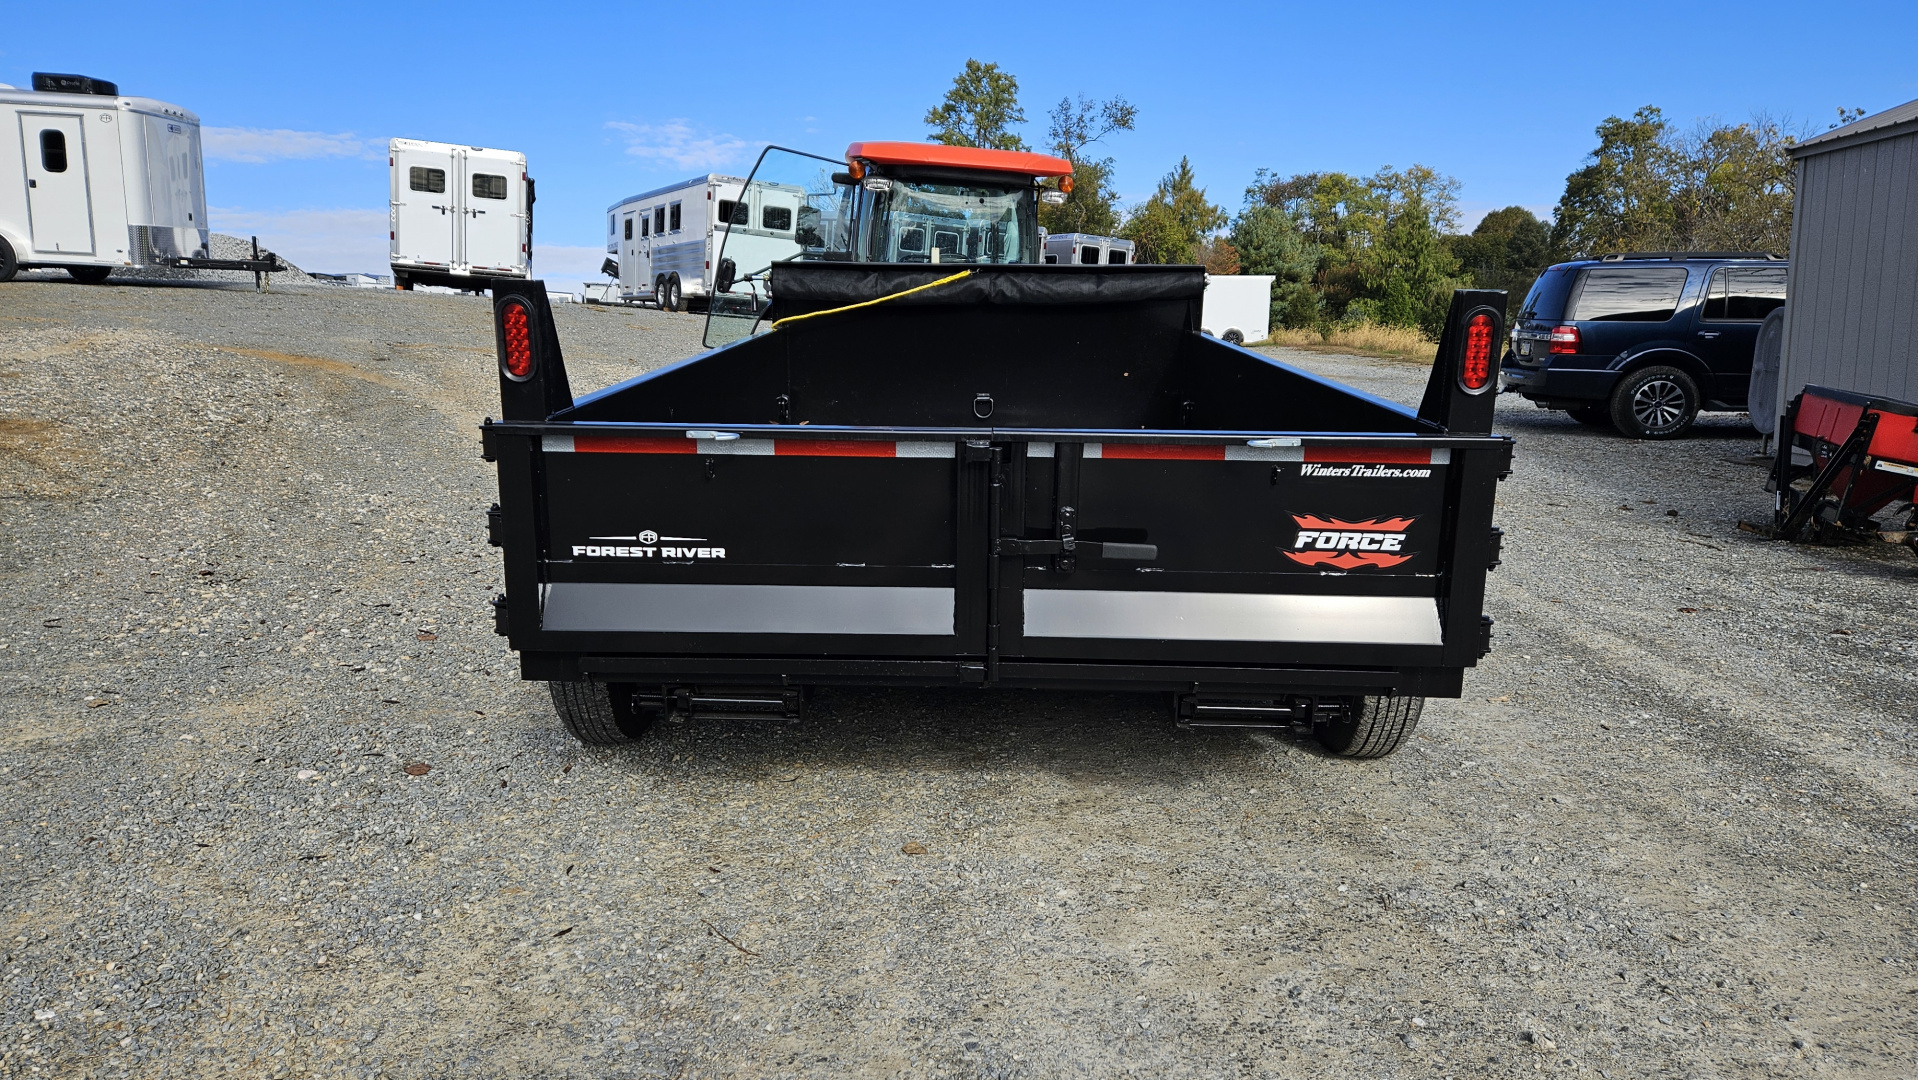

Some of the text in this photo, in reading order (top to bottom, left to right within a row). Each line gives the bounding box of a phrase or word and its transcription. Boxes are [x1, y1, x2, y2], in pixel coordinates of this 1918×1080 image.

[1300, 464, 1431, 478] WintersTrailers.com
[1294, 531, 1407, 551] FORCE
[572, 546, 726, 558] FOREST RIVER
